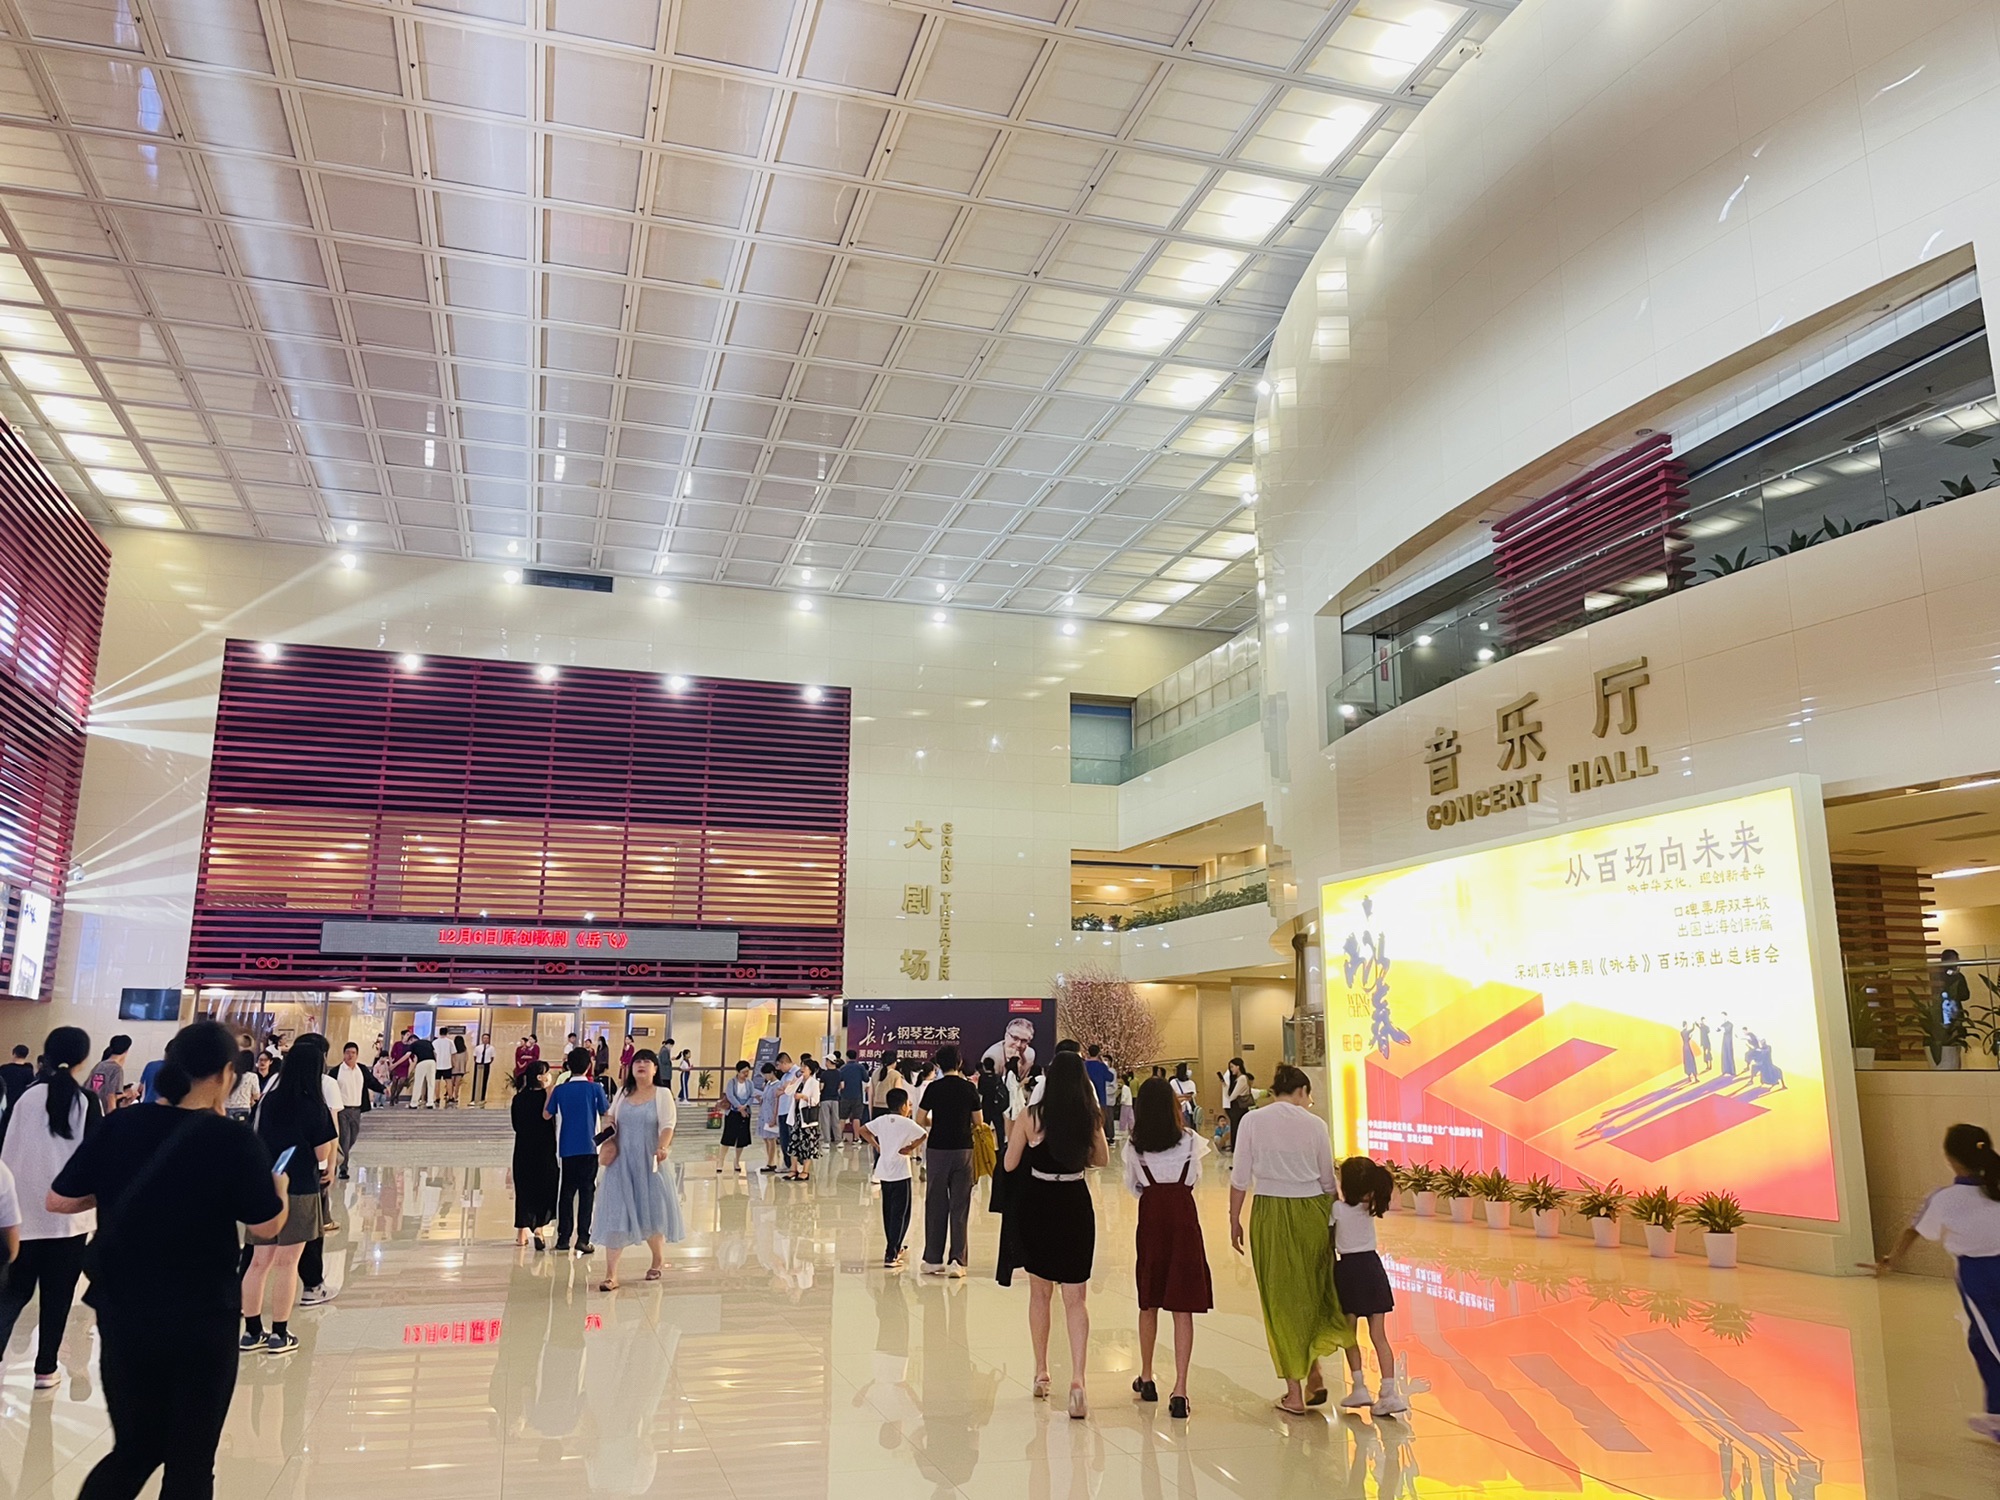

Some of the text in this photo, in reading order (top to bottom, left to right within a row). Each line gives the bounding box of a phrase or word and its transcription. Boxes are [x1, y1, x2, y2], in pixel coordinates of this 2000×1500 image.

[1424, 656, 1650, 796] 音乐厅
[1427, 745, 1658, 830] CONCERT HALL
[1565, 820, 1764, 887] 从百场向未来
[900, 820, 933, 981] 大剧场
[938, 822, 953, 981] GRAND THEATER
[1674, 896, 1770, 918] 口碑票房双丰收
[1677, 914, 1773, 938] 出国出海创新篇
[1514, 943, 1780, 980] 深圳原创舞剧《咏春》百场演出总结会
[897, 1026, 961, 1040] 钢琴艺术家
